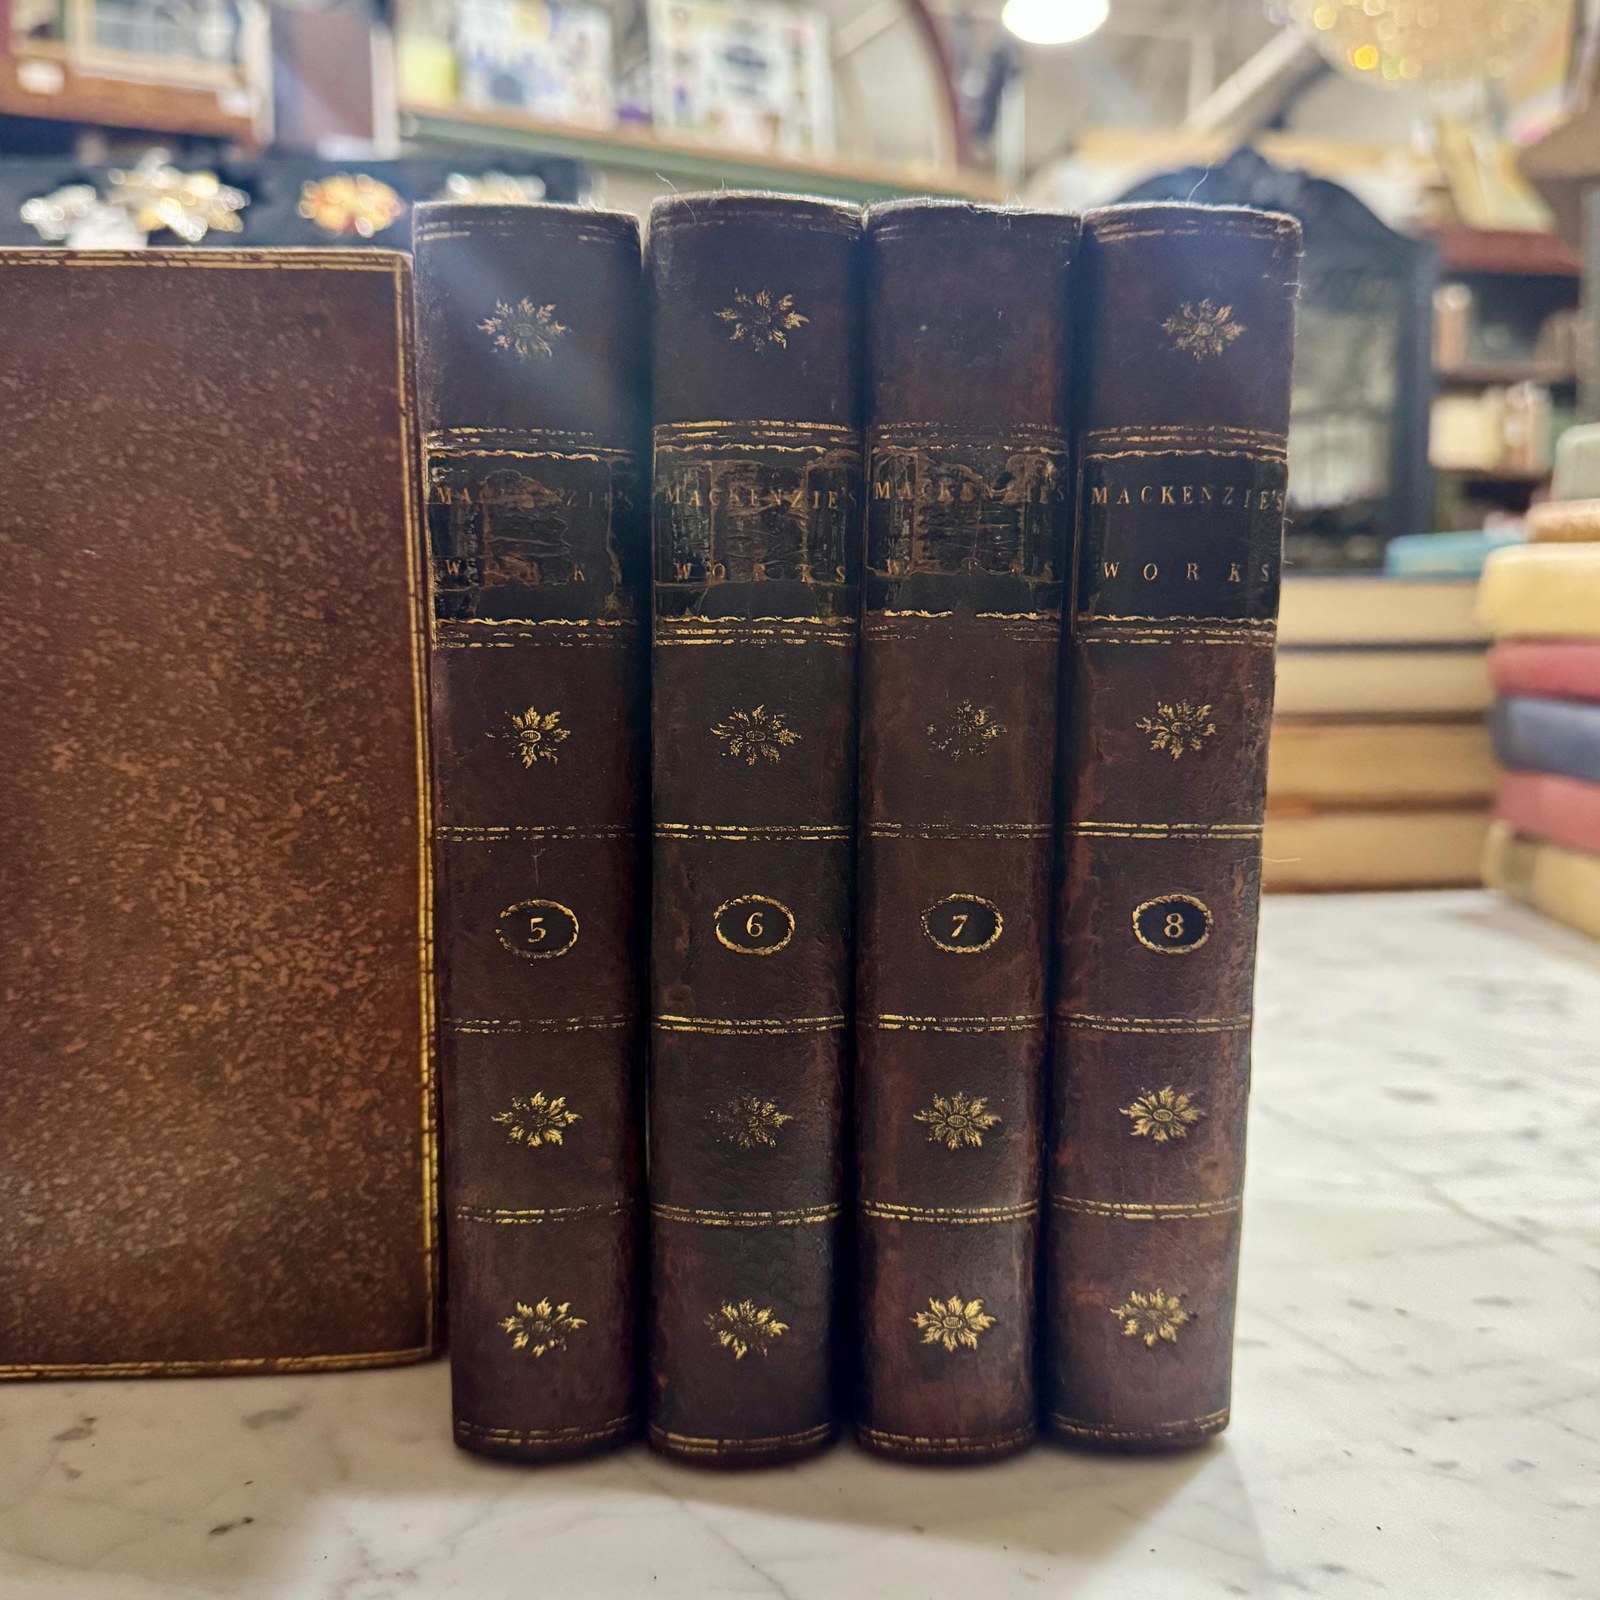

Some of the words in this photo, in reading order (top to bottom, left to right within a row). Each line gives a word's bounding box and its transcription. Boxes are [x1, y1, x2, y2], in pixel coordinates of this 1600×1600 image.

[1091, 485, 1284, 512] MACKENZIE'S
[674, 561, 846, 584] WORKS
[1103, 561, 1271, 583] WORKS
[527, 917, 547, 944] 5
[745, 911, 764, 938] 6
[951, 914, 969, 938] 7
[1164, 912, 1184, 939] 8
